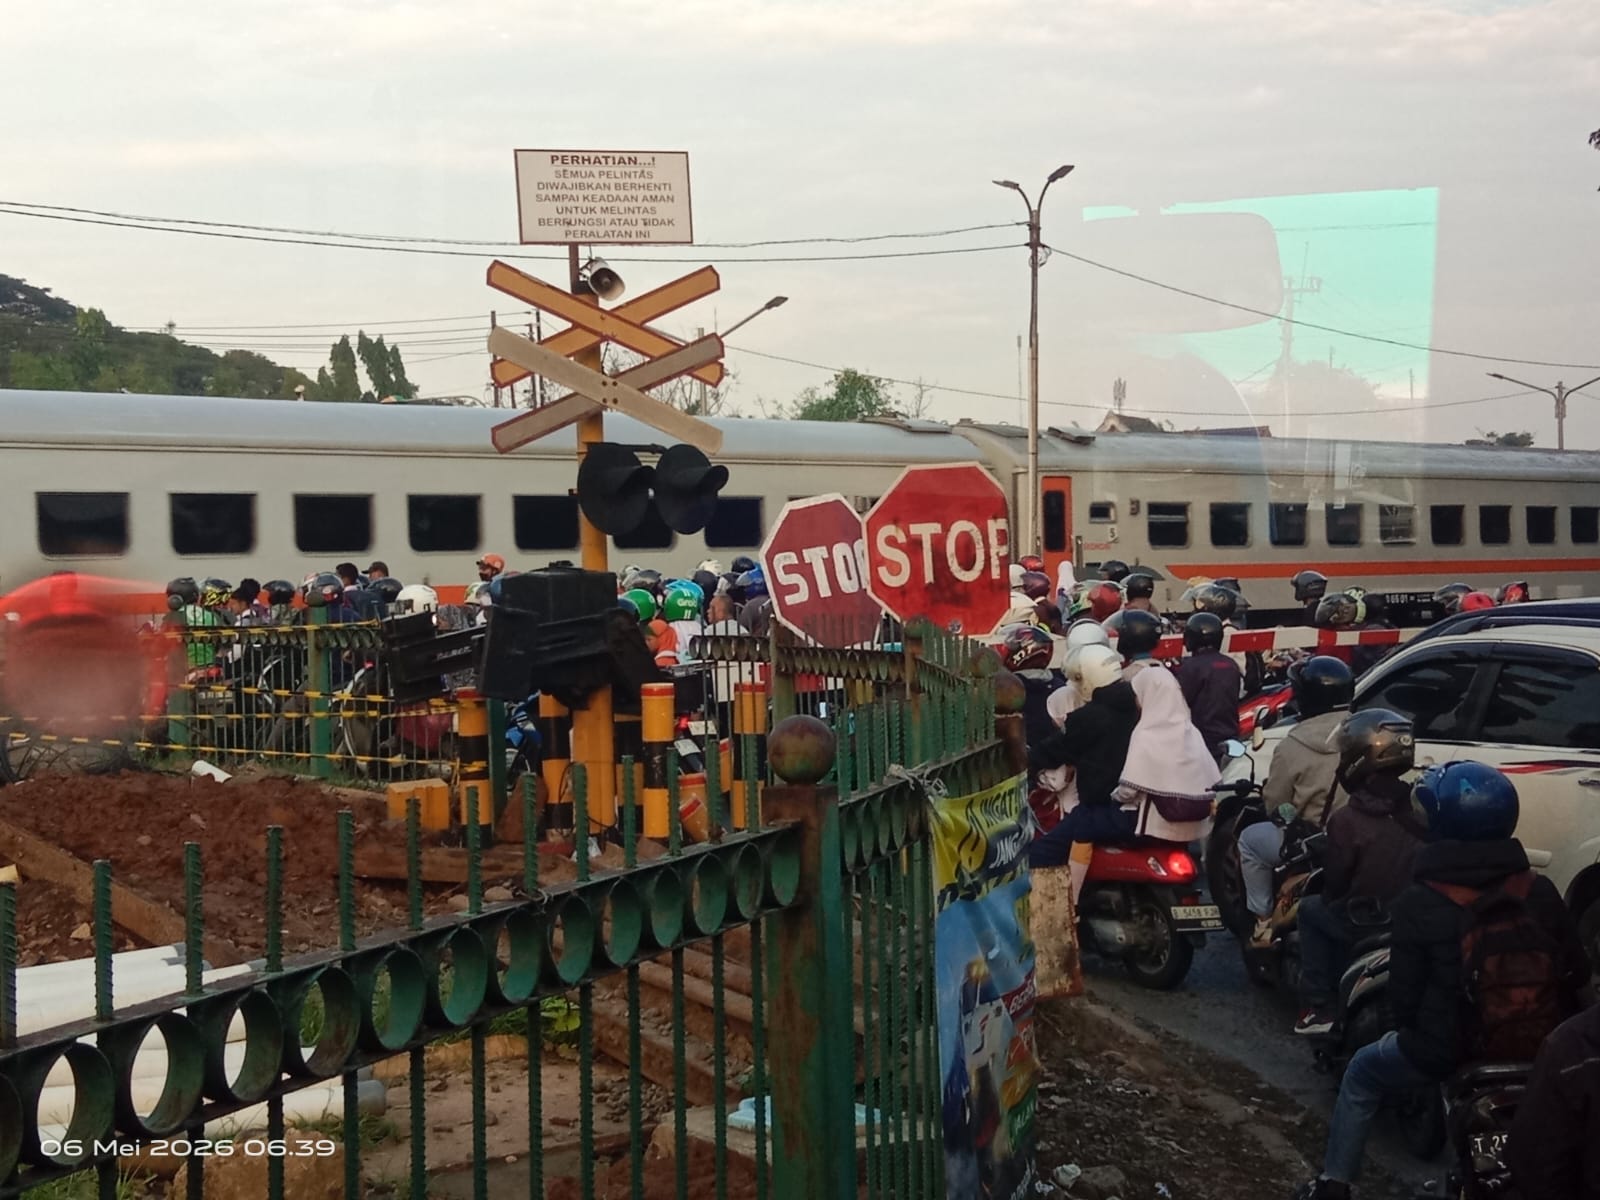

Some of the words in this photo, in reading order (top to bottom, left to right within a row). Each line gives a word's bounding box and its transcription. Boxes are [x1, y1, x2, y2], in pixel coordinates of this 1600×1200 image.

[554, 169, 596, 180] SEMUA
[598, 169, 654, 180] PELINTAS
[536, 181, 611, 191] DIWAJIBKAN
[614, 182, 672, 192] BERHENTI
[535, 193, 579, 203] SAMPAI
[582, 193, 639, 203] KEADAAN
[641, 194, 675, 204] AMAN
[556, 206, 598, 215] UNTUK
[600, 206, 657, 216] MELINTAS
[538, 217, 606, 227] BERFUNGSI
[609, 217, 639, 227] ATAU
[642, 217, 676, 227] TIDAK
[564, 229, 632, 239] PERALATAN
[635, 230, 651, 239] INI
[876, 518, 1009, 588] STOP
